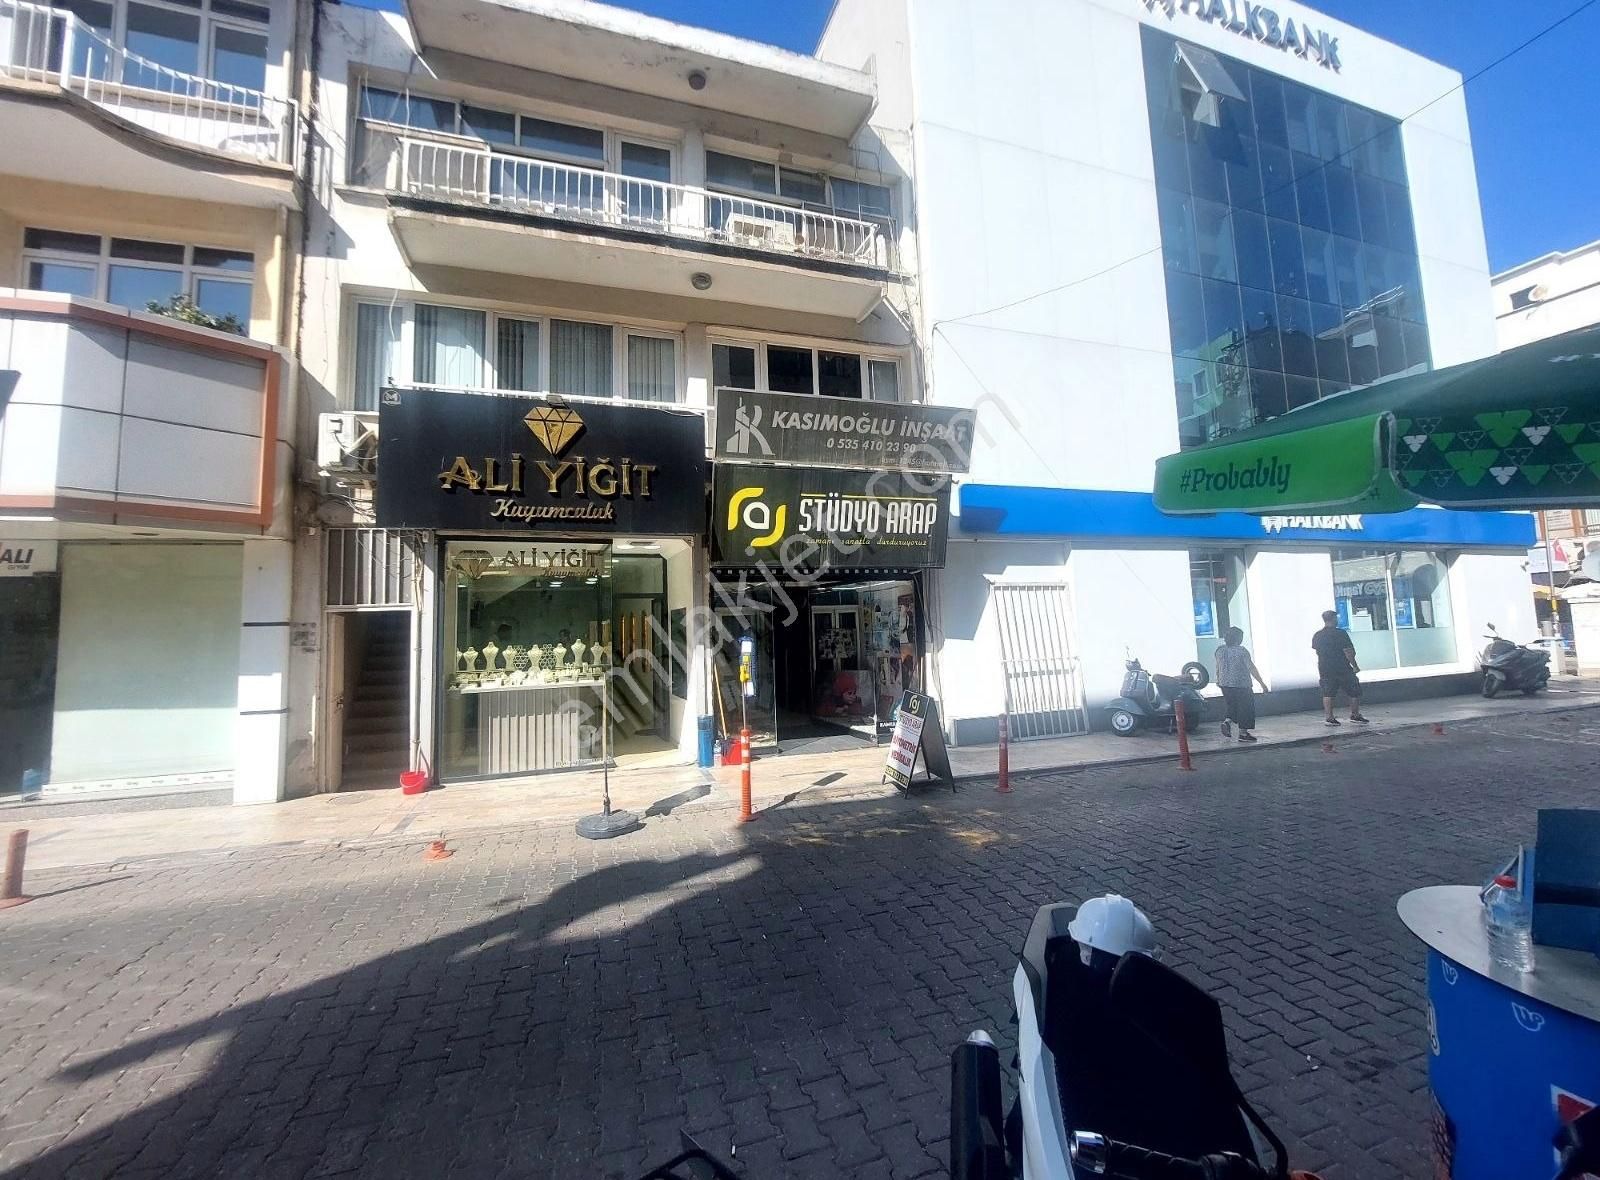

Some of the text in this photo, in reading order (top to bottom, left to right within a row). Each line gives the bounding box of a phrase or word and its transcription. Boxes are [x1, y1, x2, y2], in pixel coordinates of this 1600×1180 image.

[771, 411, 967, 442] KASIMOĞLU İNŞAAT
[826, 439, 833, 448] 0
[837, 439, 859, 450] 535
[861, 440, 883, 451] 410
[886, 441, 900, 452] 23
[437, 453, 657, 496] ALİ YİĞİT
[1180, 456, 1292, 494] #Probably
[490, 498, 614, 522] Kuyumculuk
[799, 492, 938, 538] STÜDYO ARAP
[876, 537, 928, 548] durduruyoruz
[500, 547, 602, 568] ALİ YİĞİT
